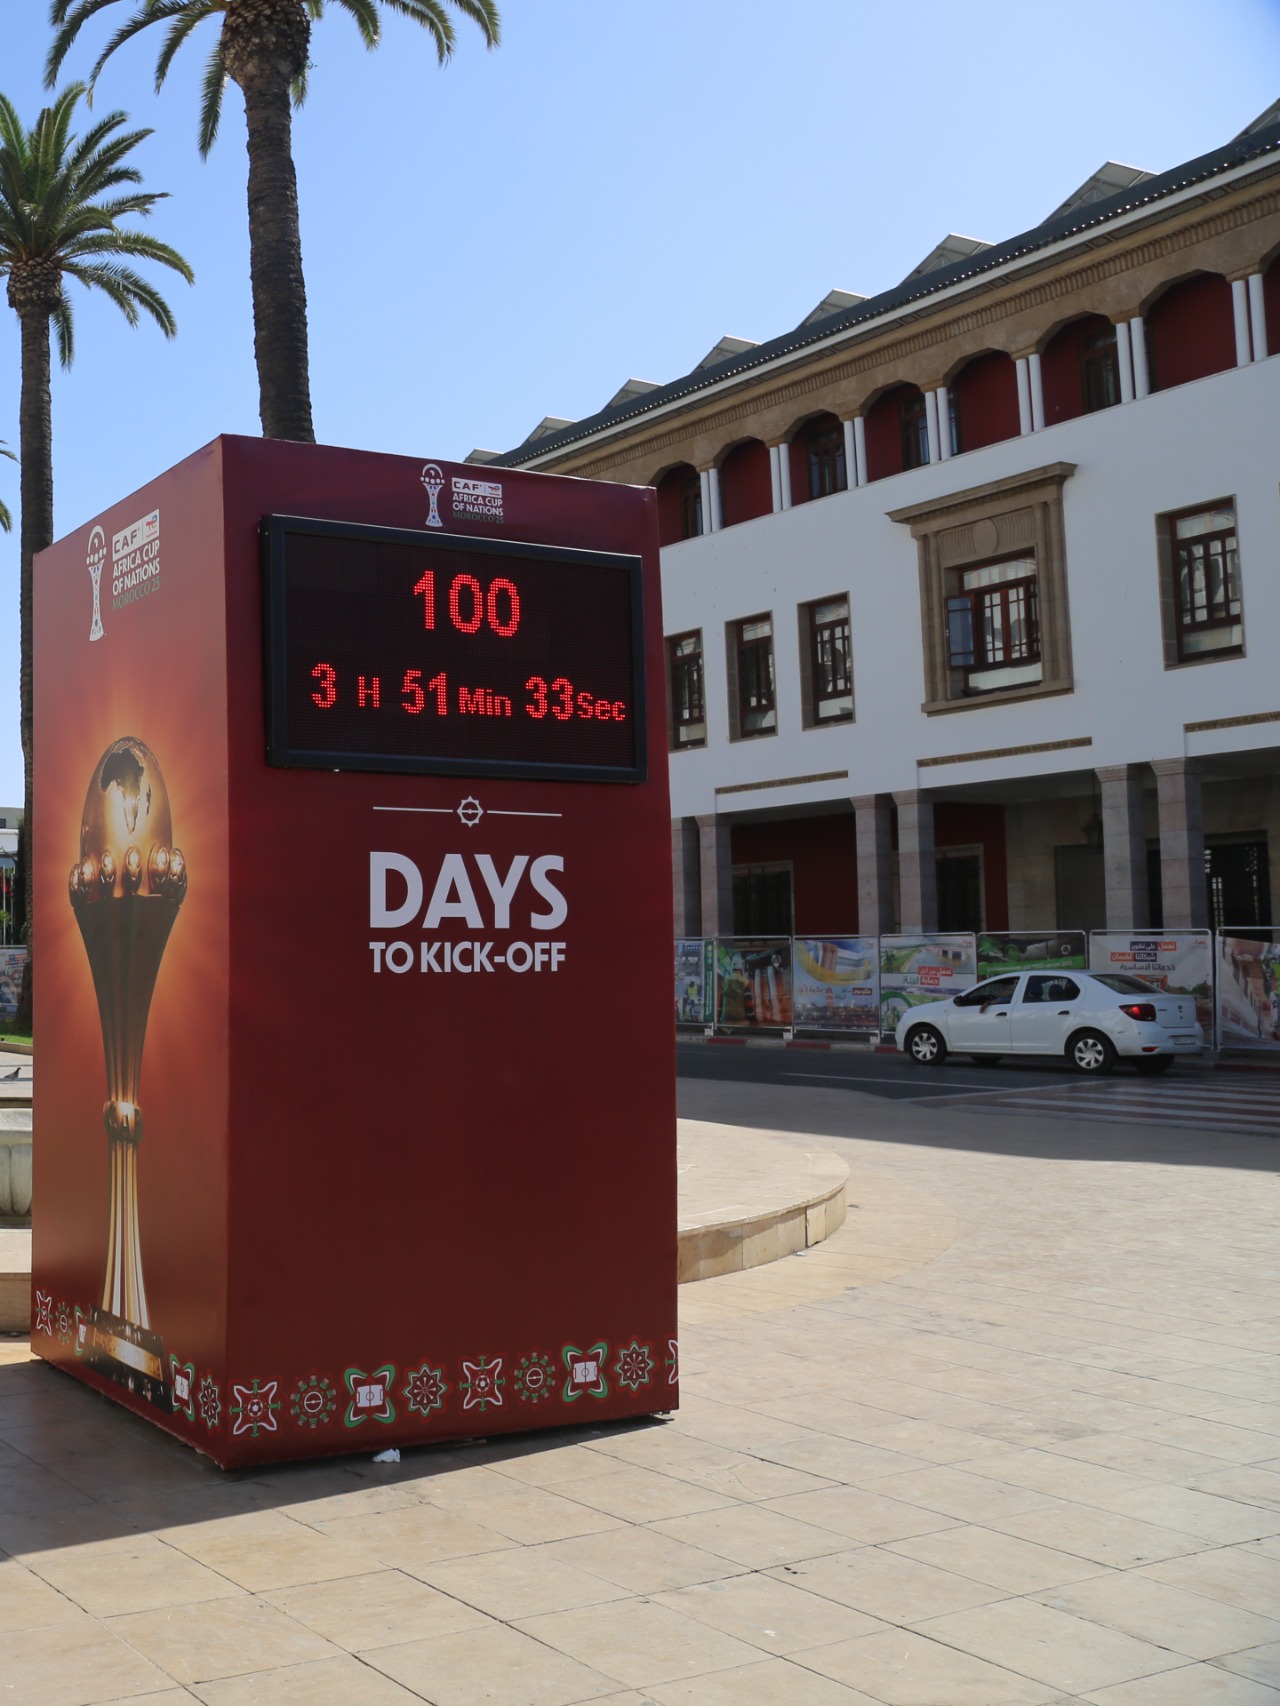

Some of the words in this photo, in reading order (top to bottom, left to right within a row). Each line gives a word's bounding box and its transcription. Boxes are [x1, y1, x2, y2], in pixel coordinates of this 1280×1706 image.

[452, 492, 484, 505] AFRICA
[485, 497, 503, 507] CUP
[453, 481, 480, 491] CAF
[452, 502, 465, 511] OF
[466, 505, 504, 516] NATIONS
[452, 511, 494, 523] MOROCCO
[495, 515, 504, 524] 25
[113, 529, 138, 555] CAF
[113, 550, 141, 579] AFRICA
[142, 540, 160, 562] CUP
[112, 578, 123, 596] OF
[124, 558, 160, 590] NATIONS
[112, 581, 150, 611] MOROCCO
[151, 576, 160, 592] 25
[412, 570, 520, 636] 100
[311, 663, 336, 708] 3
[357, 676, 380, 708] H
[401, 669, 447, 716] 51
[458, 686, 512, 716] Min
[370, 851, 568, 930] DAYS
[369, 941, 414, 973] TO
[420, 941, 566, 973] KICK-OFF
[1158, 942, 1175, 951] نعمل
